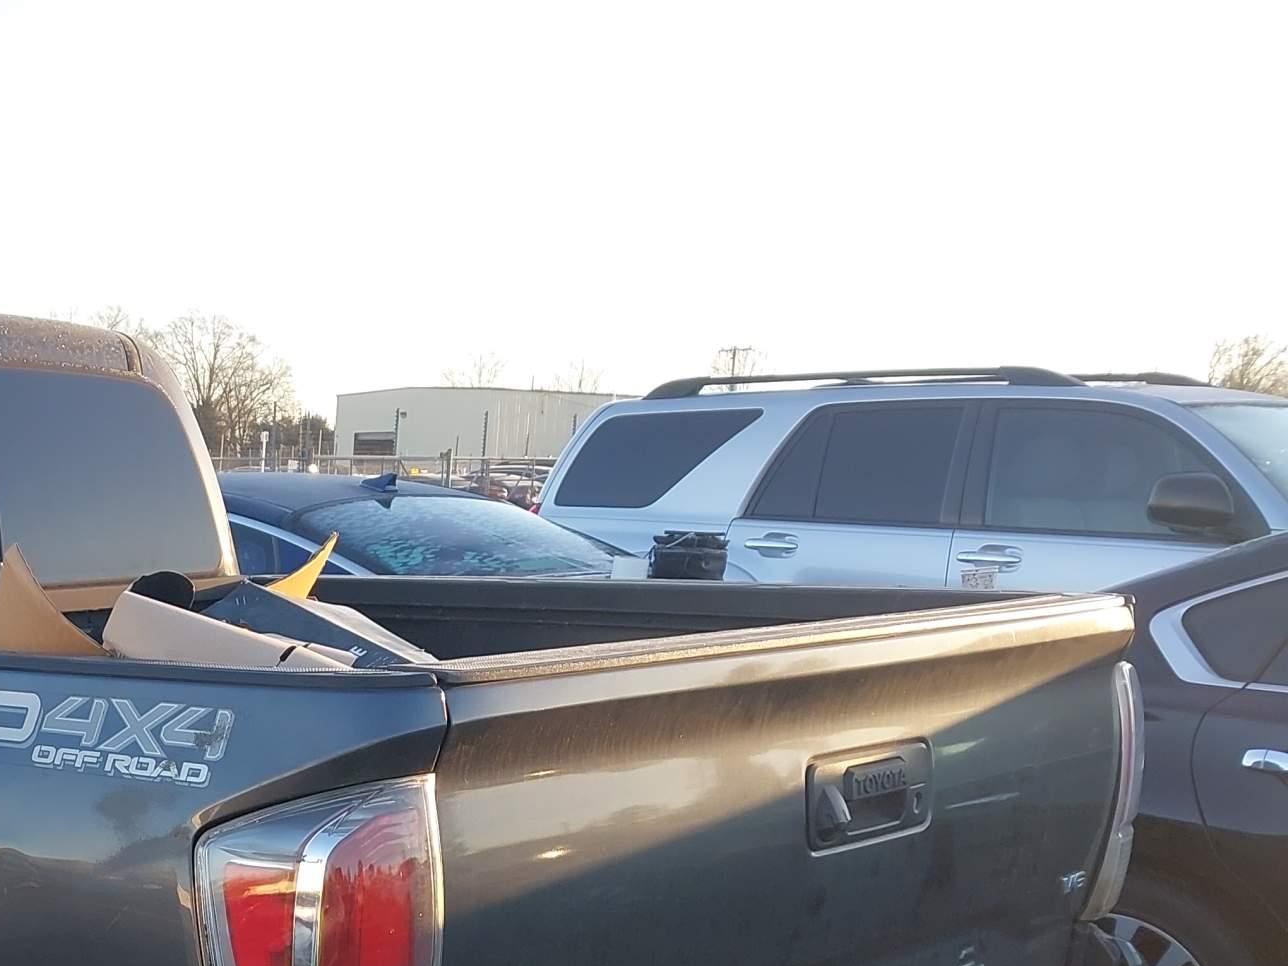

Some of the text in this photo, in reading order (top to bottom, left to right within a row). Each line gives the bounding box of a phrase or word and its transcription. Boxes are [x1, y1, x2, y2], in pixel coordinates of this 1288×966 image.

[31, 744, 211, 787] OFF ROAD
[853, 767, 907, 796] TOYOTA
